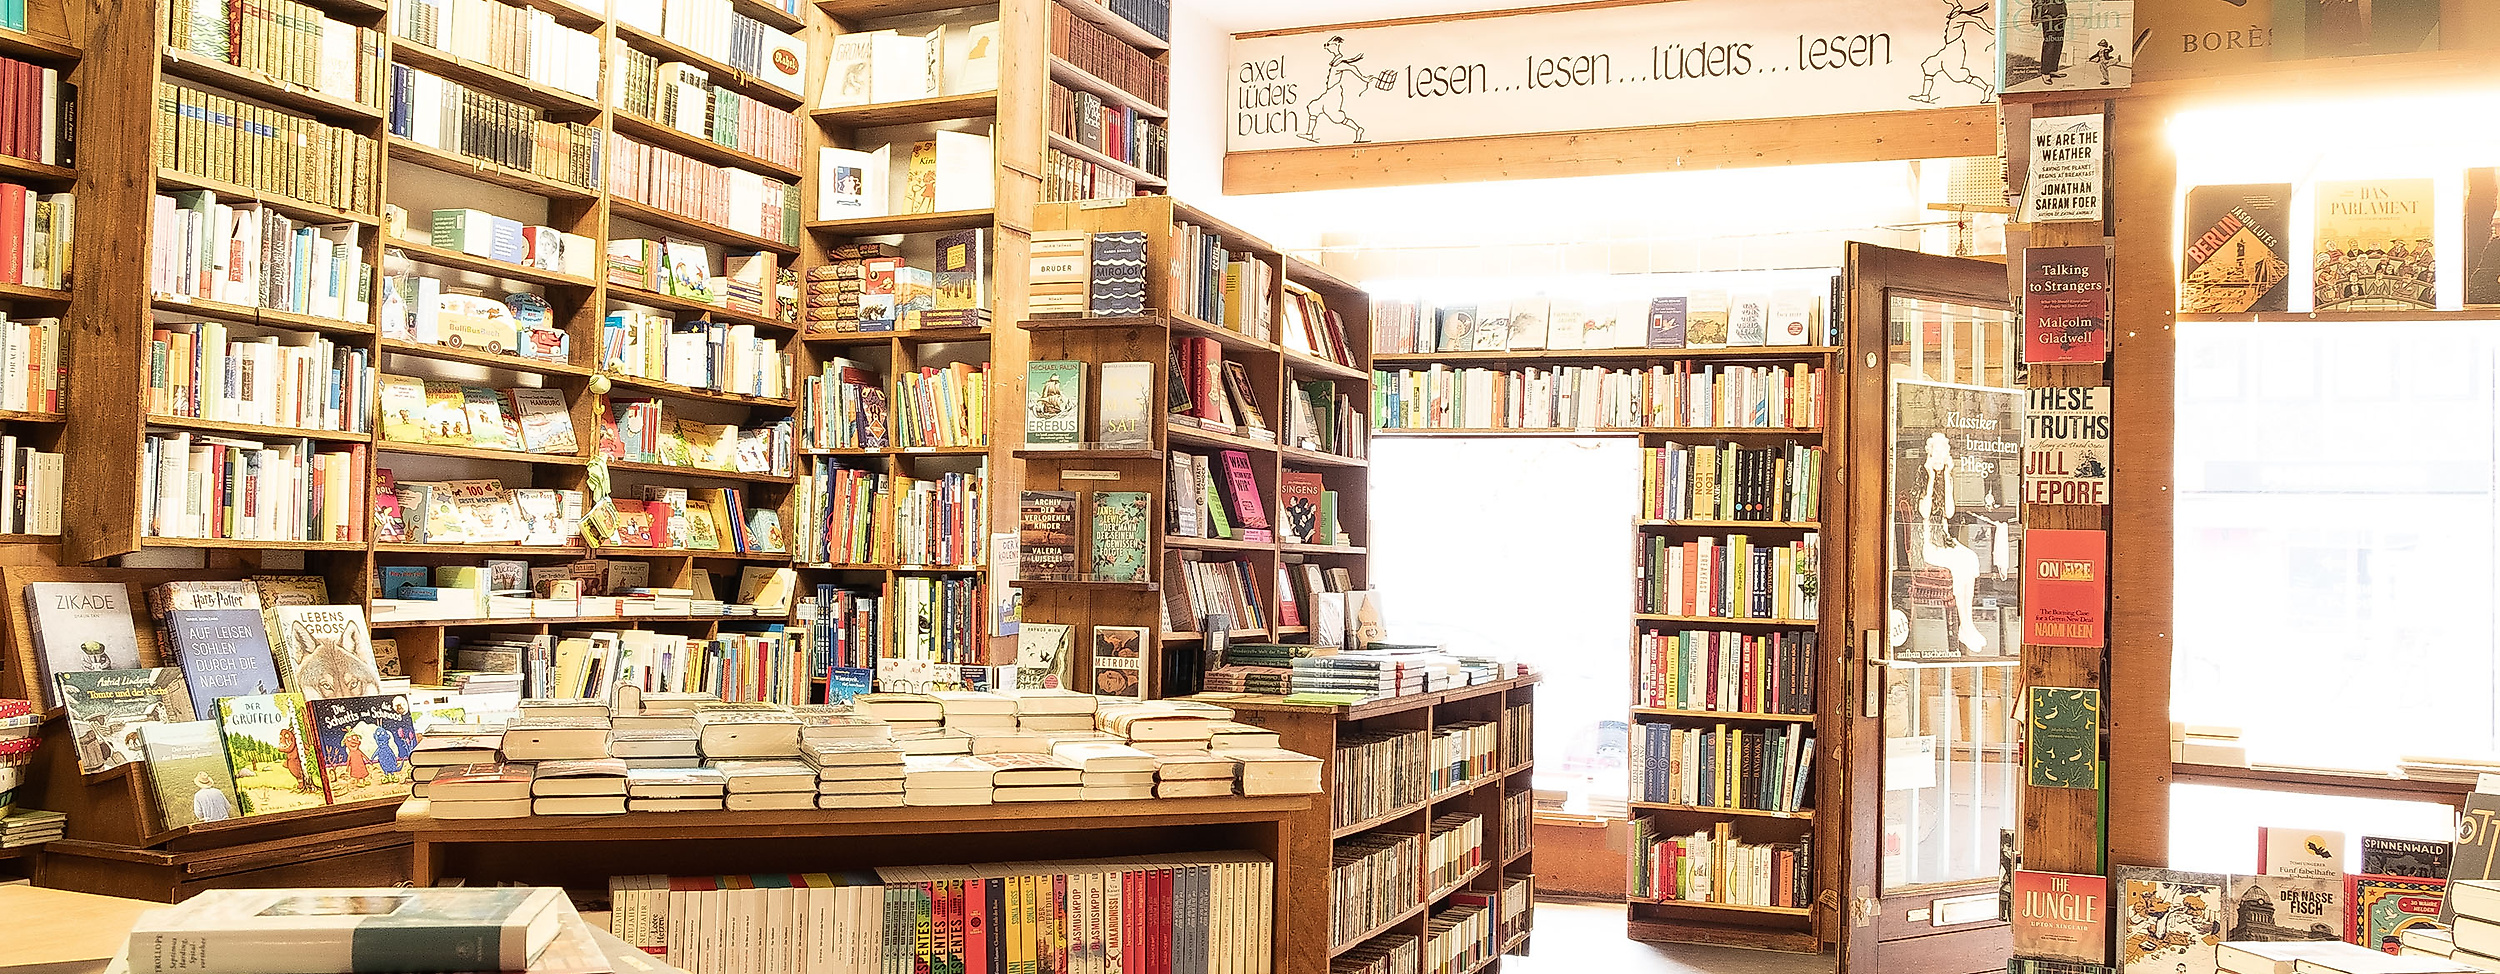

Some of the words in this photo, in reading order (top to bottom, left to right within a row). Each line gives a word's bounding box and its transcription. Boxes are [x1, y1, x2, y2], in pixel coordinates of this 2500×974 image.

[1798, 31, 1892, 71] lesen
[1240, 55, 1286, 83] axel
[1239, 82, 1297, 109] lüders
[1238, 108, 1298, 136] buch
[2036, 135, 2052, 147] WE
[2055, 133, 2076, 146] ARE
[2079, 131, 2098, 144] THE
[2042, 147, 2092, 161] WEATHER
[2041, 182, 2092, 196] JONATHAN
[2360, 186, 2389, 200] DAS
[2035, 197, 2070, 210] SAFRAN
[2072, 196, 2097, 208] FOER
[2331, 200, 2419, 215] PARLAMENT
[2230, 205, 2255, 230] JASON
[2253, 225, 2279, 249] LUTES
[2187, 212, 2243, 265] BERLIN
[2042, 264, 2090, 278] Talking
[2029, 282, 2042, 292] to
[2045, 280, 2102, 293] Strangers
[2038, 316, 2092, 328] Malcolm
[2038, 331, 2092, 344] Gladwell
[2027, 387, 2094, 410] THESE
[1029, 420, 1076, 432] EREBUS
[1947, 411, 1998, 431] Klassiker
[2026, 416, 2108, 439] TRUTHS
[1966, 432, 2018, 454] brauchen
[1960, 454, 1995, 478] Pflege
[2026, 451, 2069, 475] JILL
[1282, 485, 1318, 495] SINGENS
[1695, 472, 1703, 495] LEON
[1705, 472, 1713, 495] LEON
[465, 486, 484, 496] 100
[2026, 480, 2104, 504] LEPORE
[1034, 498, 1062, 506] ARCHIV
[1040, 506, 1055, 514] DER
[1097, 506, 1116, 515] JANET
[1103, 514, 1122, 523] LEWIS
[1034, 522, 1060, 530] KINDER
[1103, 524, 1117, 532] DER
[1096, 531, 1110, 540] DER
[1111, 531, 1135, 540] SEINEM
[1105, 539, 1138, 548] GEWISSEN
[1032, 547, 1062, 555] VALERIA
[1100, 548, 1123, 556] FOLGTE
[1031, 555, 1062, 563] LUISELLI
[2039, 561, 2059, 578] ON
[55, 595, 115, 610] ZIKADE
[192, 593, 215, 610] Harry
[215, 591, 243, 607] Potter
[301, 612, 344, 623] LEBENS
[189, 627, 211, 640] AUF
[215, 625, 253, 639] LEISEN
[306, 623, 344, 634] GROSS
[2035, 622, 2064, 637] NAOMI
[2066, 623, 2093, 638] KLEIN
[191, 642, 237, 656] SOHLEN
[196, 657, 235, 671] DURCH
[239, 657, 258, 669] DIE
[1094, 658, 1140, 668] METROPOL
[97, 676, 121, 687] Astrid
[200, 673, 239, 688] NACHT
[87, 690, 115, 699] Tomte
[115, 689, 131, 698] und
[131, 688, 145, 697] der
[144, 687, 169, 696] Fuchs
[244, 702, 261, 710] DER
[332, 703, 346, 714] Die
[381, 701, 392, 711] die
[232, 712, 282, 726] GRÜFFELO
[2364, 838, 2444, 855] SPINNENWALD
[2279, 866, 2297, 874] Fünf
[2298, 868, 2336, 877] fabelhafte
[2050, 877, 2070, 893] THE
[2280, 890, 2300, 903] DER
[2301, 892, 2334, 905] NASSE
[2022, 891, 2098, 923] JUNGLE
[2290, 901, 2323, 916] FISCH
[640, 904, 648, 944] NEUJAHR
[1073, 888, 1082, 951] BLASMUSIKPOP
[1091, 887, 1100, 950] BLASMUSIKPOP
[1109, 898, 1119, 949] MAKARIONISSI
[2055, 923, 2088, 931] SINCLAIR
[170, 937, 178, 969] Septimus
